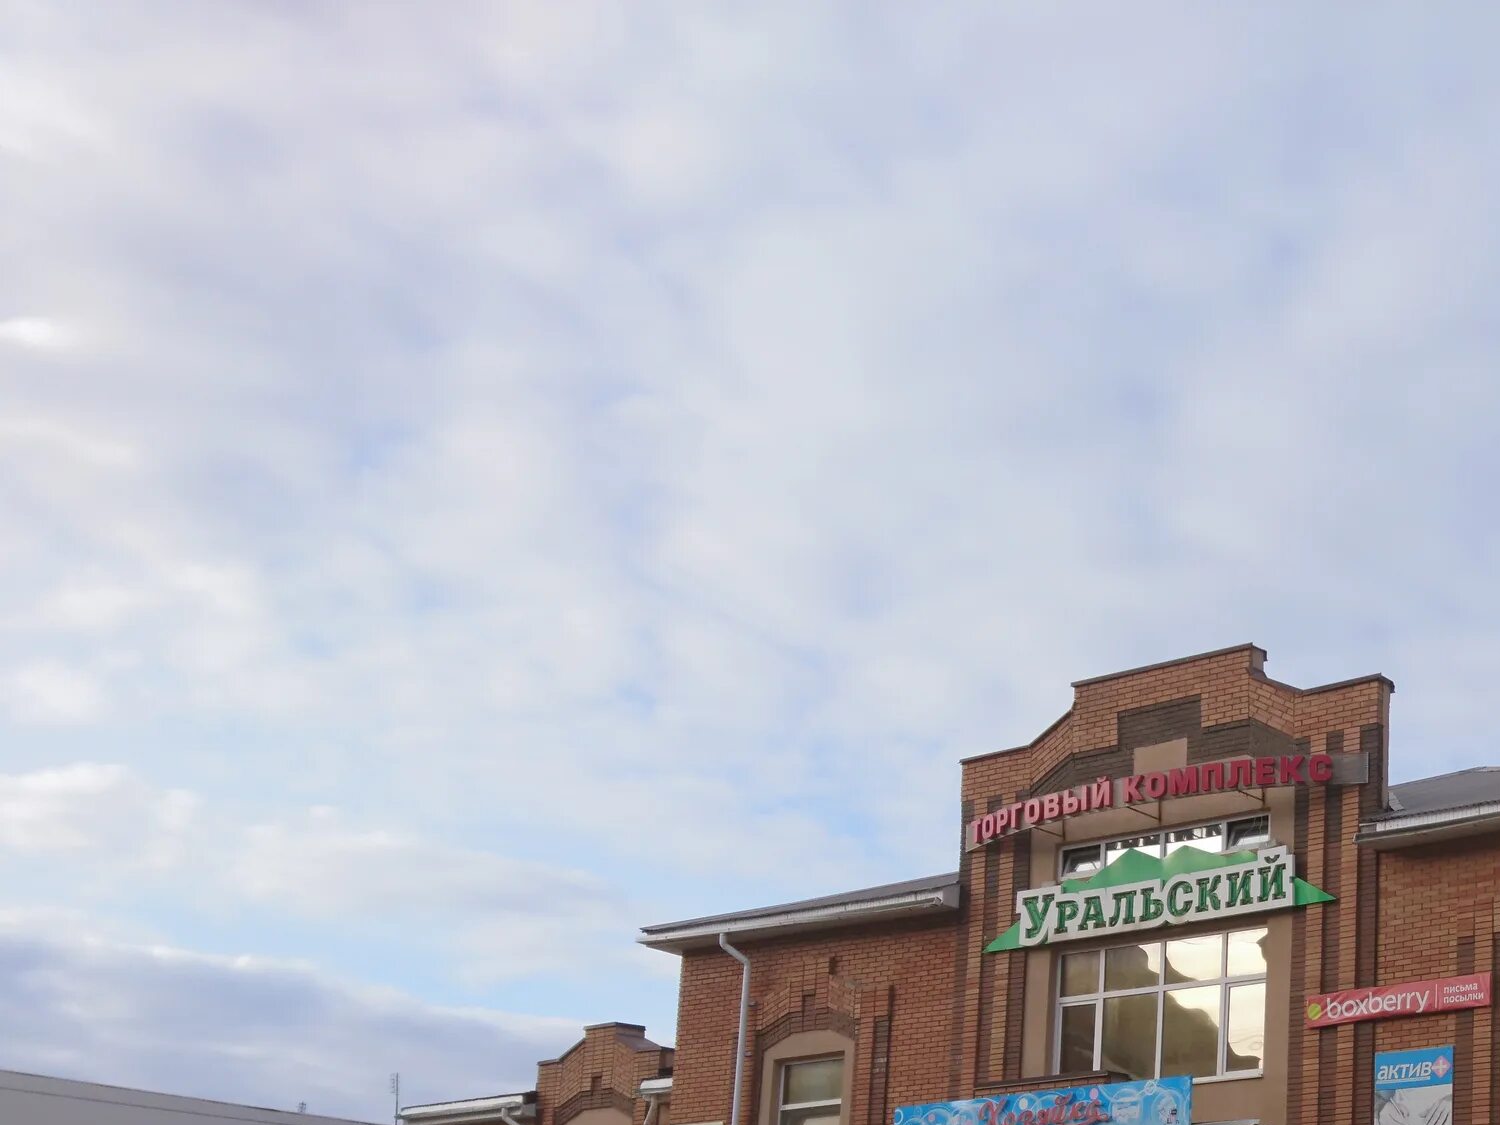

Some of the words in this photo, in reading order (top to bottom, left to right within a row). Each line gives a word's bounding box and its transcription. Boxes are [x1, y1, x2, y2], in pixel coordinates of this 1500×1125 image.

[969, 777, 1113, 844] ТОРГОВЫЙ
[1123, 754, 1333, 803] КОМПЛЕКС
[1443, 982, 1478, 994] письма
[1443, 992, 1484, 1005] посылки
[1326, 989, 1430, 1020] boxberry
